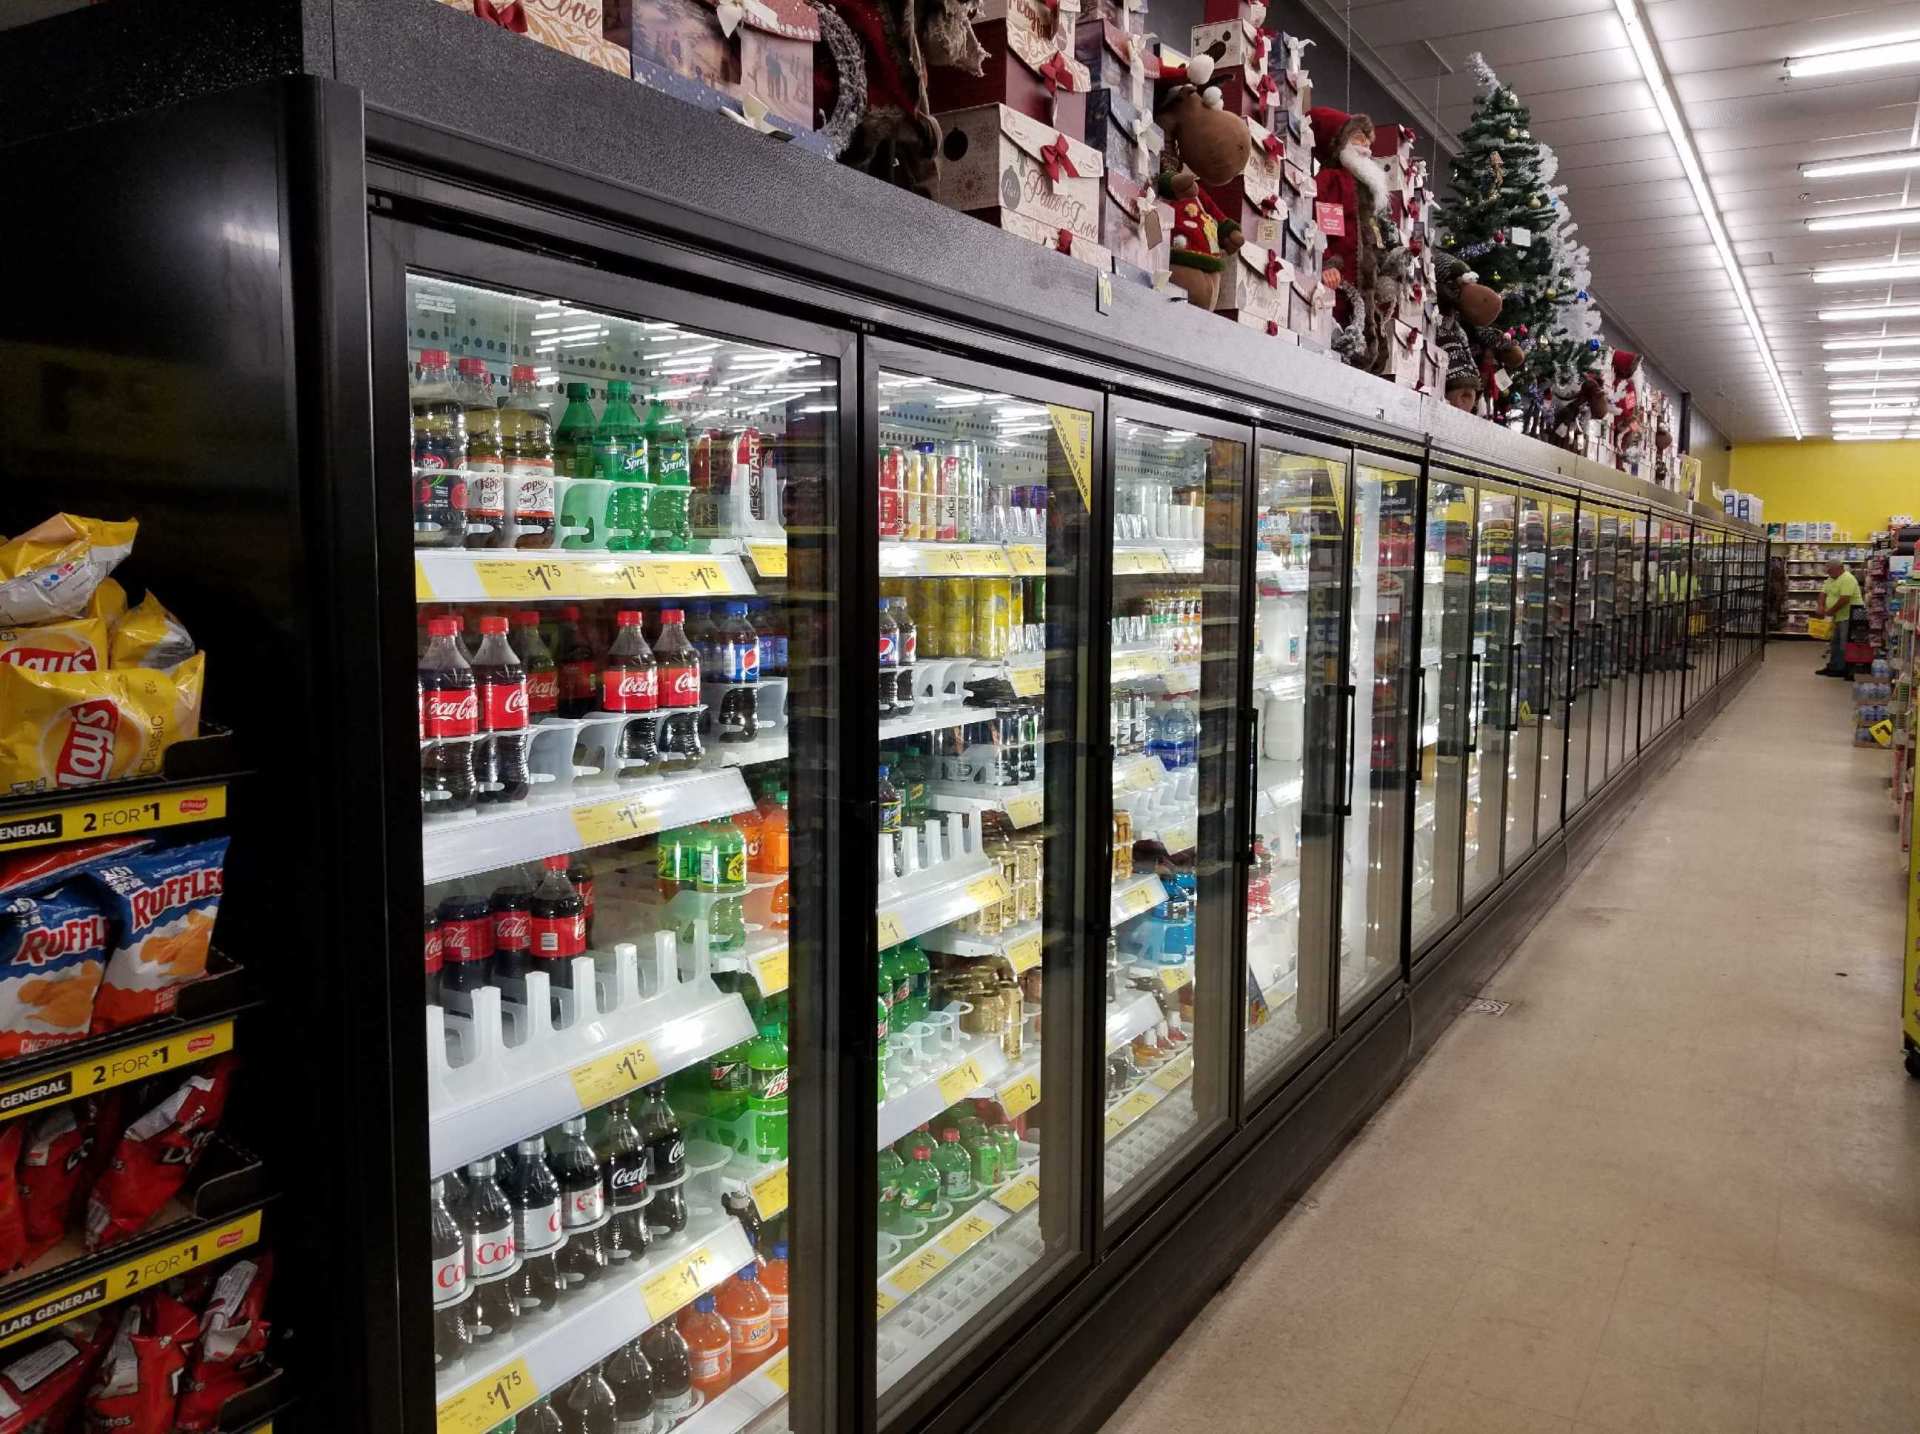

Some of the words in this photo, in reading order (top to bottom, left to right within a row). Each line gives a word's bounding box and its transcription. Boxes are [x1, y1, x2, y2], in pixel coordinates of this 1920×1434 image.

[0, 822, 55, 840] ENERAL
[83, 813, 97, 832] 2
[103, 808, 140, 827] FOR
[143, 802, 161, 821] $1
[92, 1066, 106, 1085] 2
[111, 1055, 149, 1077] FOR
[152, 1047, 169, 1063] $1
[125, 1270, 139, 1288] 2
[143, 1256, 181, 1280] FOR
[183, 1245, 199, 1262] $1
[36, 1287, 101, 1321] GENERAL
[487, 1369, 522, 1411] $175
